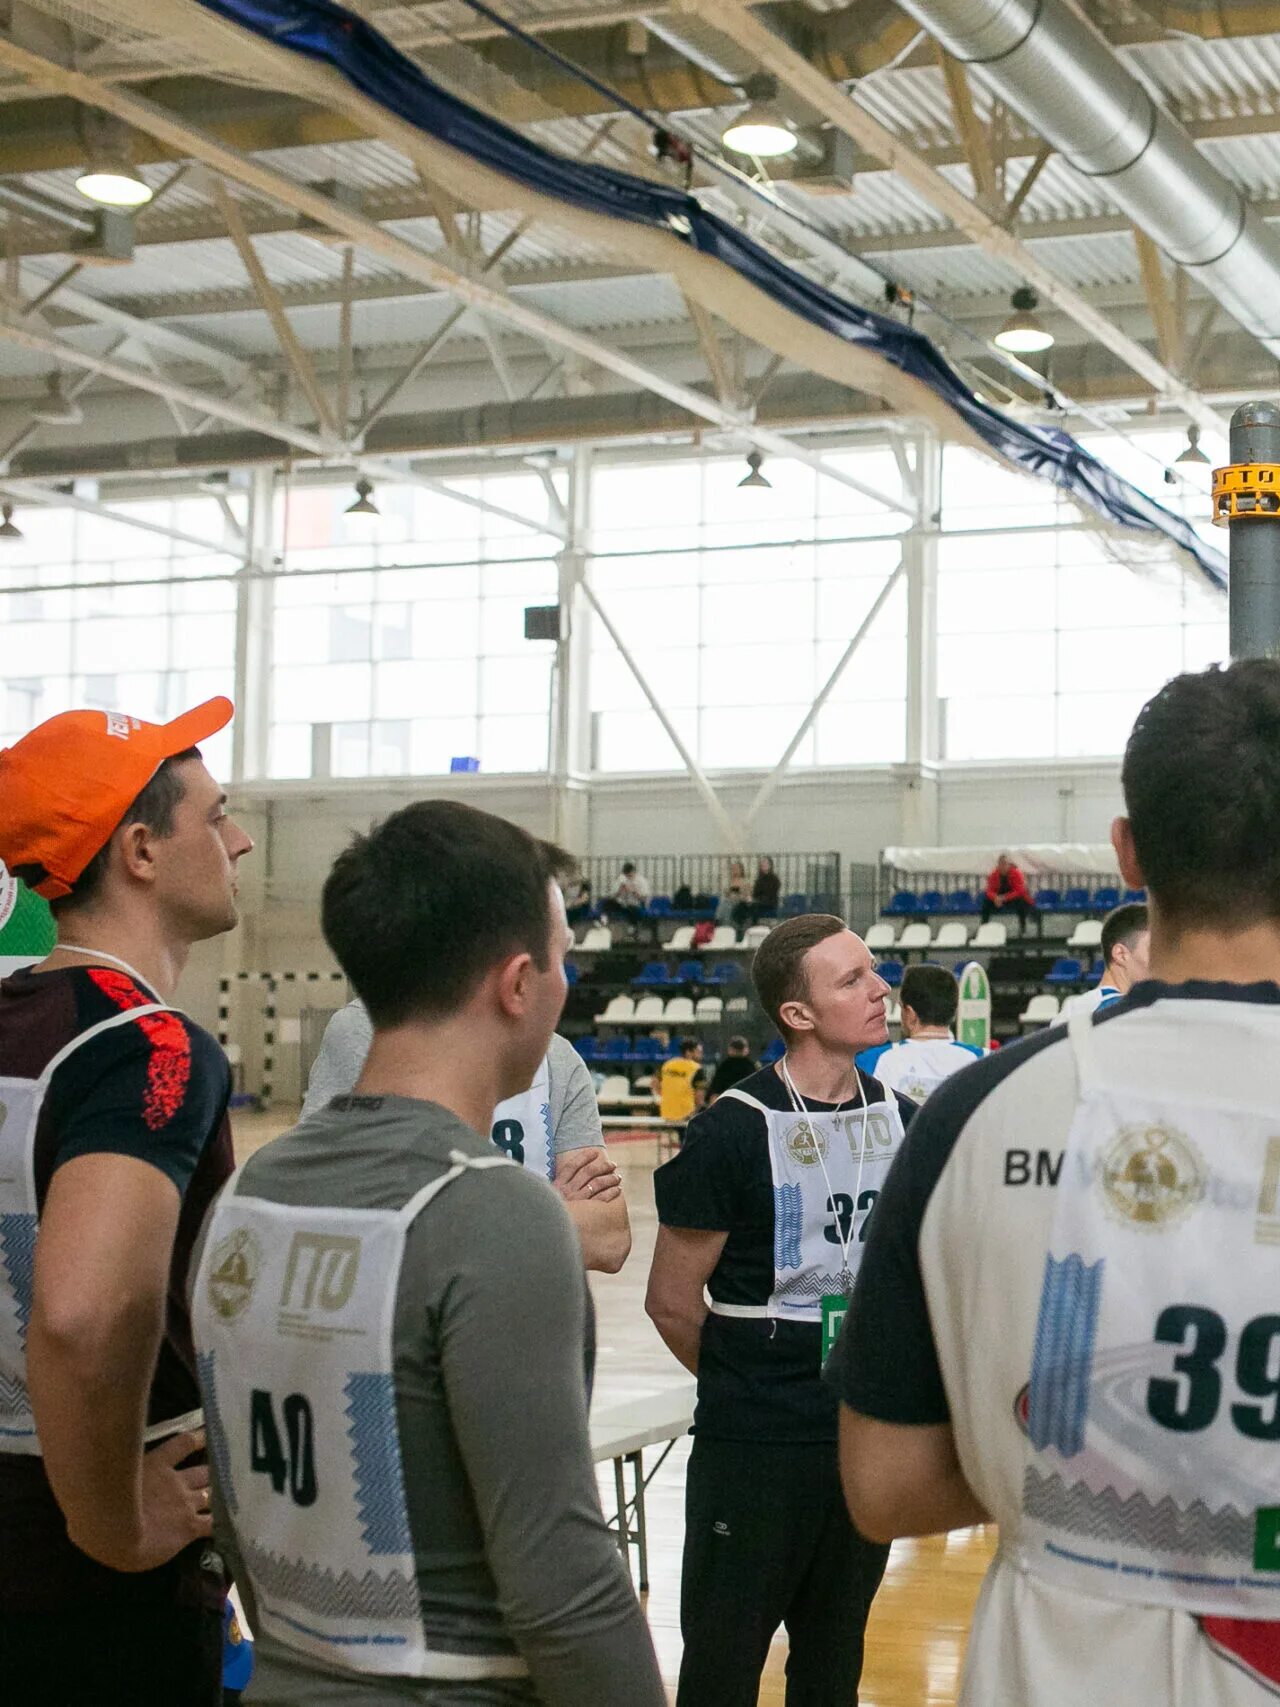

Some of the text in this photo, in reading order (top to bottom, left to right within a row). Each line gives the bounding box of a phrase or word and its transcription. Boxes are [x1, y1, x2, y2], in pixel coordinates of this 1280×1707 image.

[1222, 470, 1274, 485] ГТО
[844, 1112, 893, 1151] ГТО
[279, 1231, 362, 1313] ГТО
[250, 1388, 318, 1507] 40
